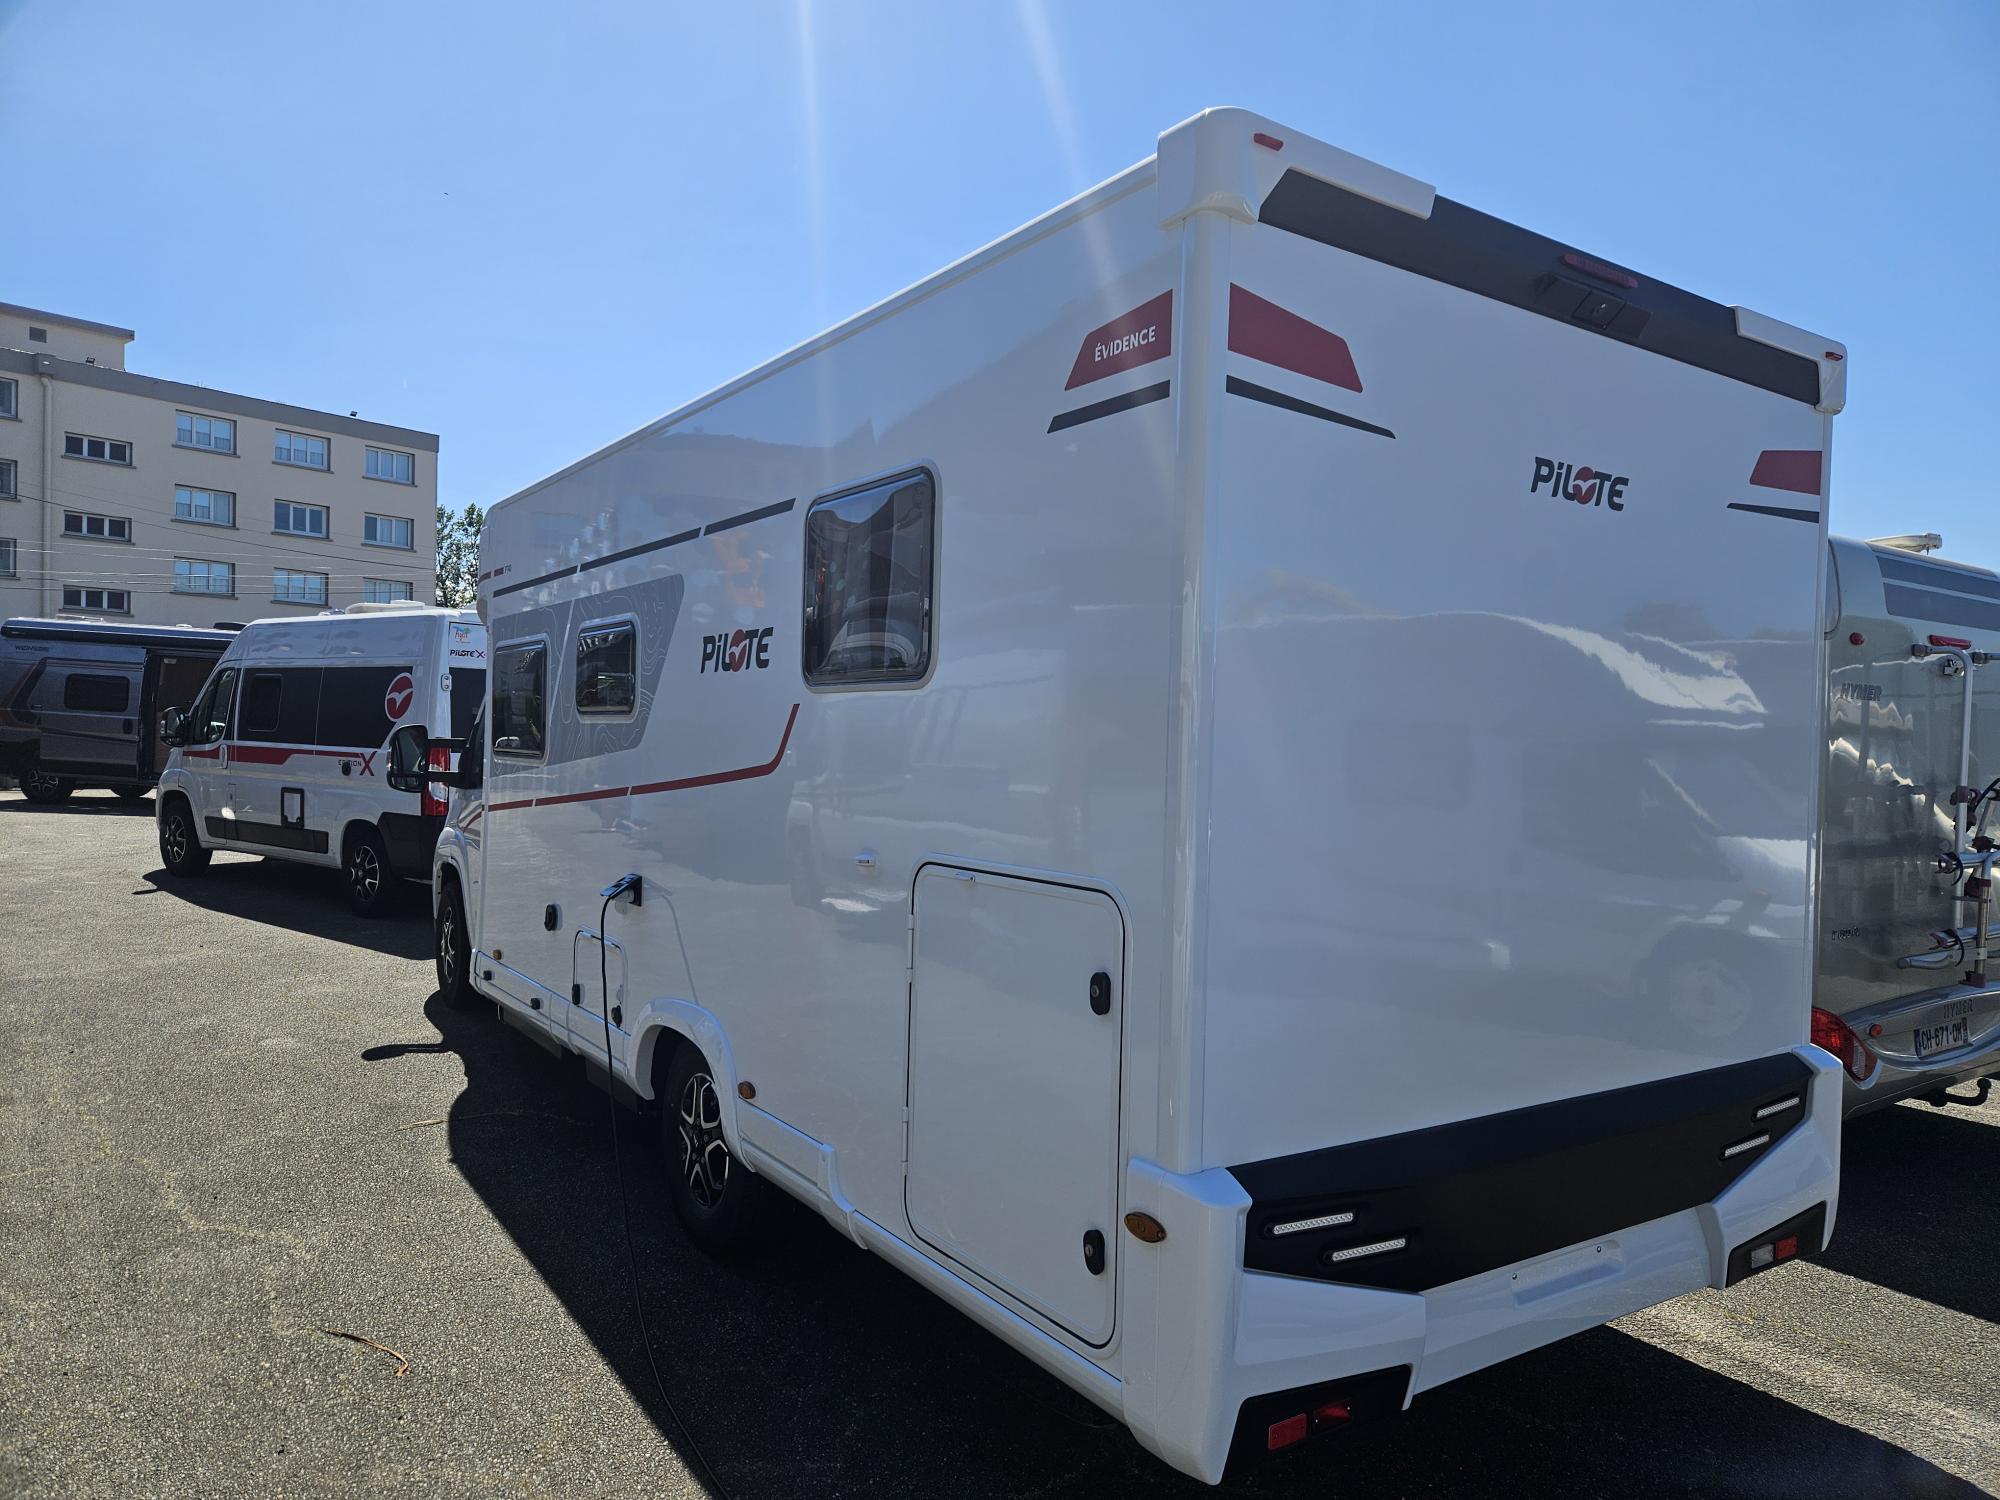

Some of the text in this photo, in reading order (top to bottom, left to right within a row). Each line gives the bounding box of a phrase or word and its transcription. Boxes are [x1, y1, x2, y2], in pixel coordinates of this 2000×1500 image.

[1094, 325, 1157, 363] ÉVIDENCE
[1840, 682, 1882, 702] HYMER
[1943, 998, 1974, 1020] HYMER
